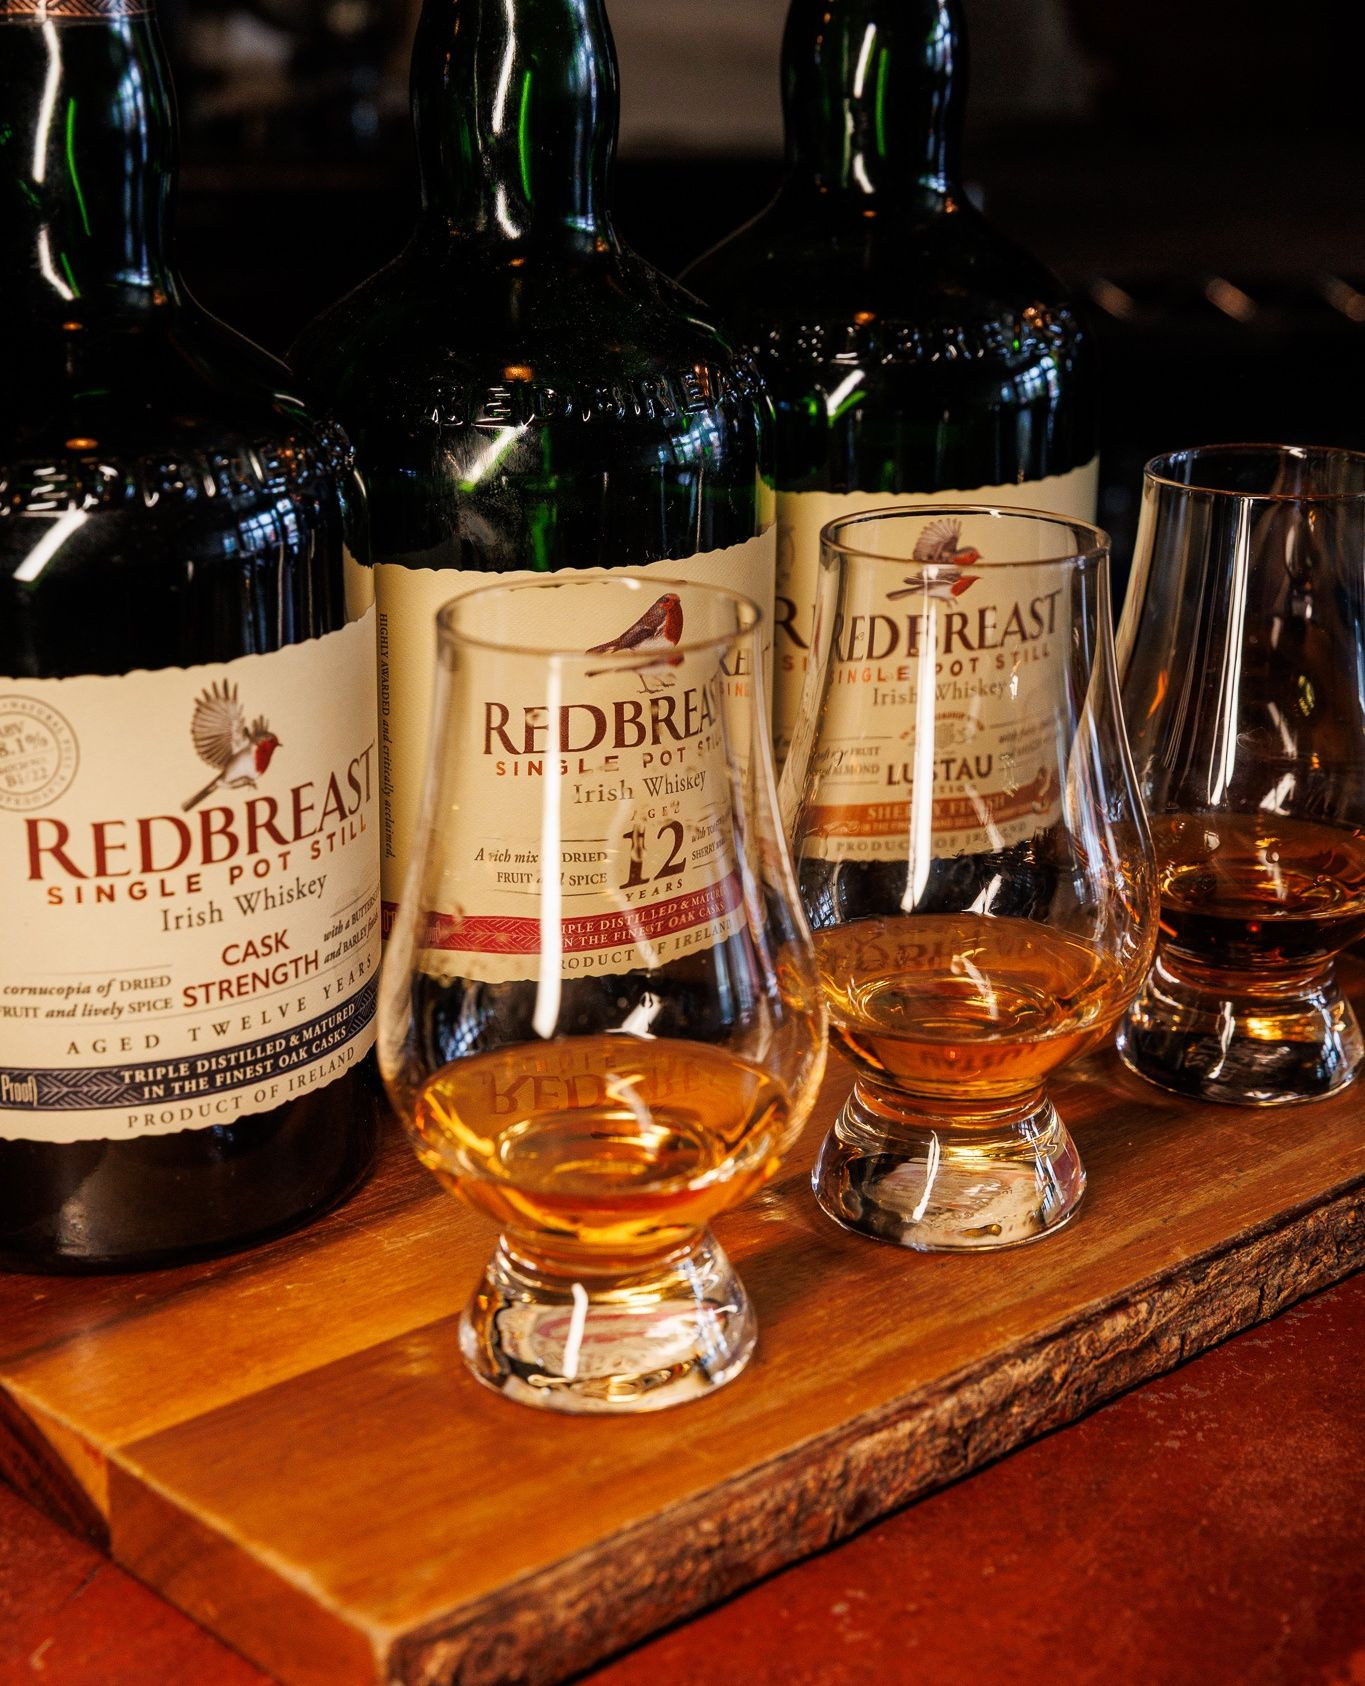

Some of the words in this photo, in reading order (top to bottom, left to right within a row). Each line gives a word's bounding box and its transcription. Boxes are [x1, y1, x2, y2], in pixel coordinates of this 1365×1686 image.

[379, 613, 390, 659] HIGHLY
[381, 660, 391, 716] AWARDED
[482, 682, 718, 755] REDBREA
[381, 744, 395, 797] critically
[643, 747, 686, 769] POT
[24, 738, 375, 881] REDBREAST
[572, 779, 634, 804] Irish
[643, 769, 706, 799] Whiskey
[47, 872, 203, 906] SINGLE
[229, 850, 292, 886] POT
[310, 812, 367, 860] STILL
[474, 847, 485, 862] A
[514, 850, 540, 864] mix
[562, 851, 608, 864] DRIED
[619, 819, 688, 891] 12
[497, 871, 534, 884] FRUIT
[568, 872, 608, 887] SPICE
[624, 878, 684, 902] YEARS
[161, 900, 224, 932] Irish
[234, 874, 328, 917] Whiskey
[561, 922, 595, 934] IPLE
[600, 903, 677, 930] DISTILLED
[681, 899, 689, 910] &
[221, 929, 290, 966] CASK
[323, 919, 343, 943] with
[323, 942, 342, 965] and
[343, 923, 367, 953] BARLEY
[578, 933, 608, 947] THE
[614, 921, 664, 941] FINEST
[669, 911, 695, 929] OAK
[3, 981, 92, 1000] cornucopia
[96, 977, 117, 998] of
[120, 975, 172, 992] DRIED
[182, 950, 320, 1008] STRENGTH
[45, 1003, 78, 1019] and
[81, 1001, 125, 1021] lively
[128, 998, 174, 1015] SPICE
[67, 1033, 161, 1056] AGED
[187, 996, 308, 1043] TWELVE
[322, 952, 372, 1001] YEARS
[120, 1064, 196, 1085] TRIPLE
[197, 1038, 286, 1075] DISTILLED
[289, 1033, 300, 1049] &
[302, 1002, 355, 1042] MATURED
[142, 1083, 167, 1100] IN
[171, 1076, 210, 1096] THE
[214, 1062, 275, 1088] FINEST
[279, 1046, 309, 1069] OAK
[312, 1025, 348, 1055] CASKS
[127, 1094, 244, 1129] PRODUCT
[253, 1085, 281, 1104] OF
[287, 1045, 356, 1093] IRELAND
